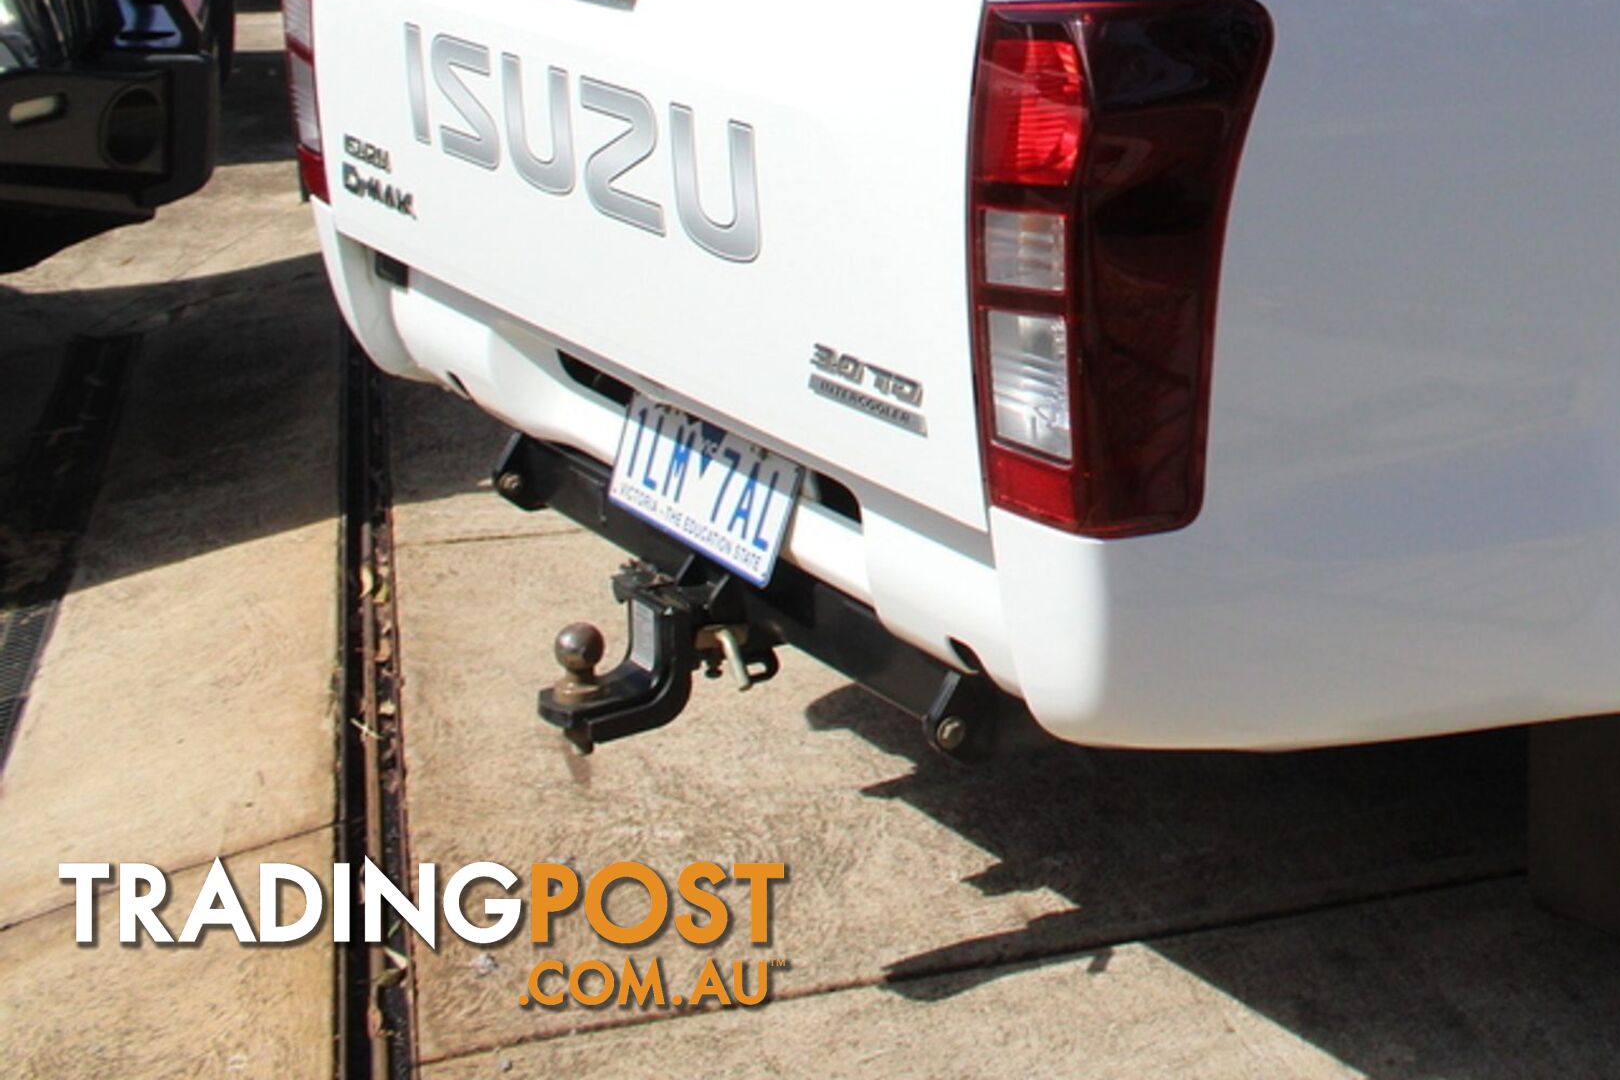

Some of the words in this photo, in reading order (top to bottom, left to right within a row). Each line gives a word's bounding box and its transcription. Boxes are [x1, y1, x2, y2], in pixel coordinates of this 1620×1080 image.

[404, 21, 762, 263] ISUZU
[820, 380, 911, 423] INTERCOOLER
[619, 482, 658, 512] VICTORIA
[665, 505, 684, 529] THE
[682, 514, 734, 553] EDUCATION
[733, 543, 763, 573] STATE
[627, 407, 696, 503] 1LM
[710, 447, 778, 552] 7AL
